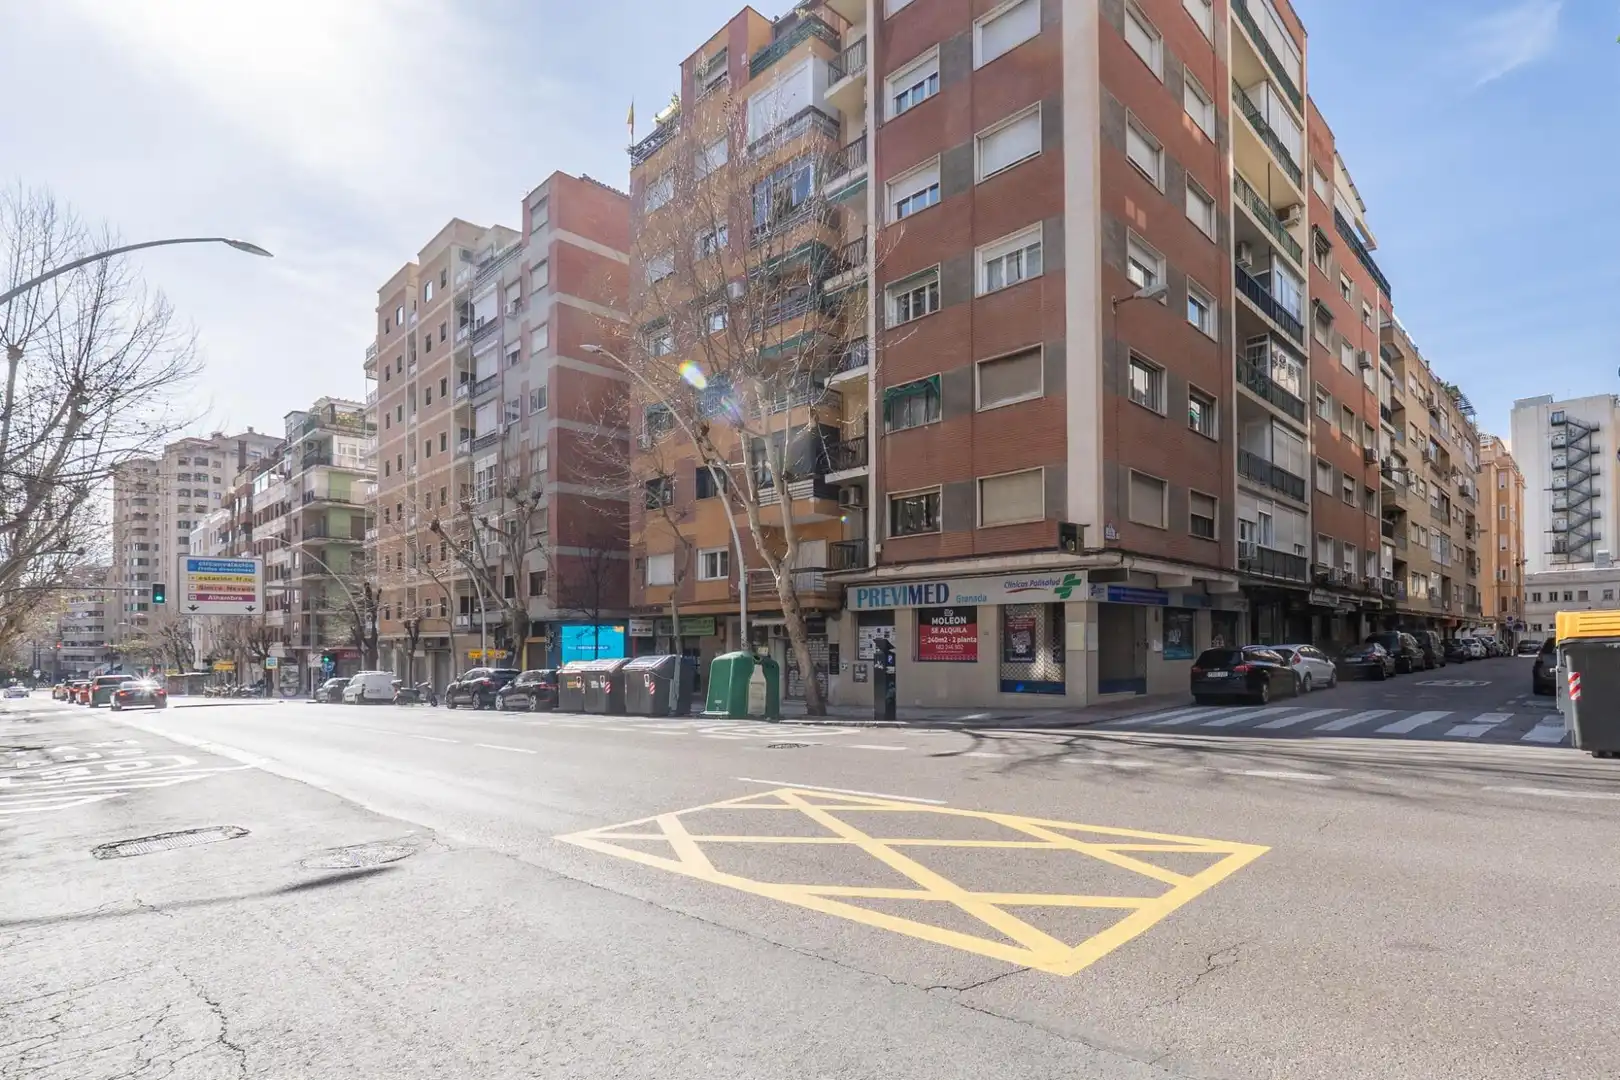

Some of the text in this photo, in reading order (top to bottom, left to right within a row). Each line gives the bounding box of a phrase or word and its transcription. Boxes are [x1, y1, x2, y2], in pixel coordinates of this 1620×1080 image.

[856, 583, 987, 608] PREVIMED Granada
[931, 616, 967, 625] MOLEON
[939, 626, 968, 635] ALQUILA
